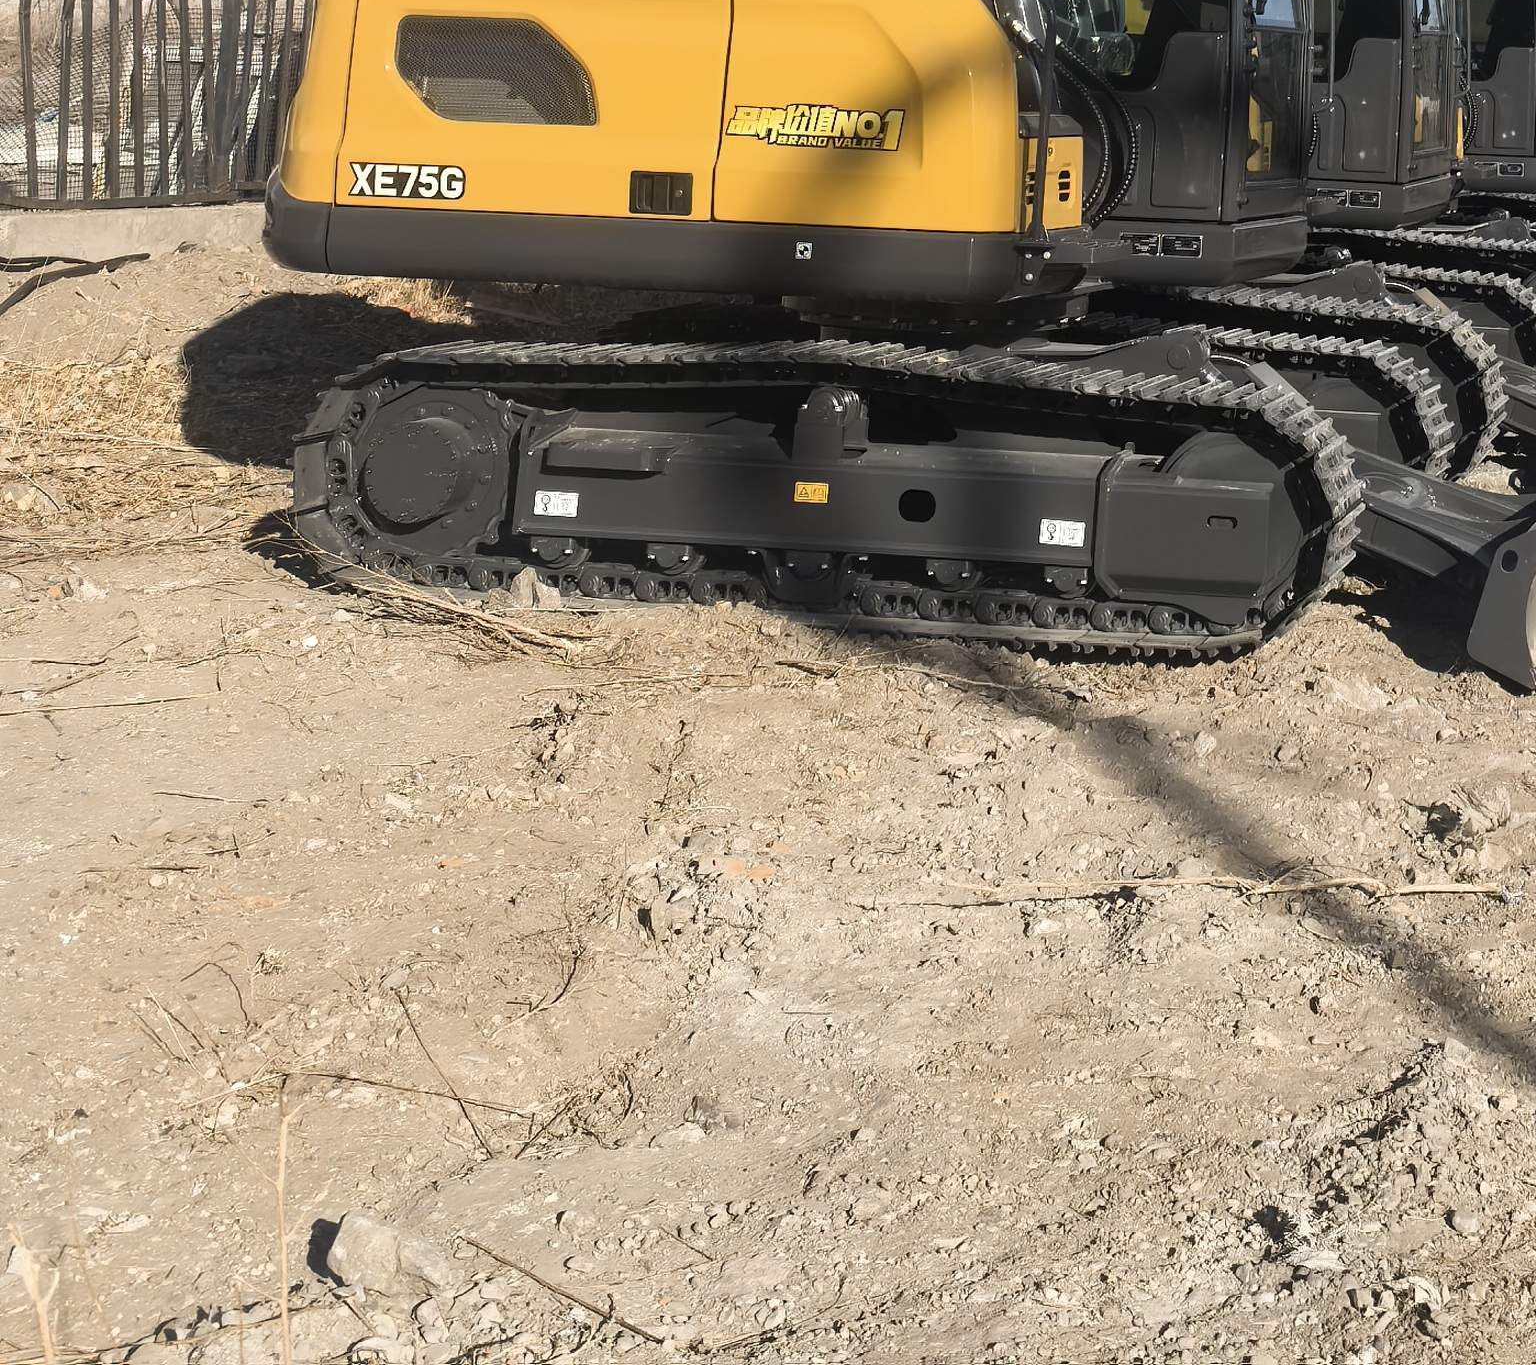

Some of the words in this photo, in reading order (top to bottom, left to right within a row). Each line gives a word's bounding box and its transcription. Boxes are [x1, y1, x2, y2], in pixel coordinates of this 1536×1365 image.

[777, 135, 828, 147] BRAND
[834, 137, 882, 149] VALUE
[350, 163, 464, 199] XE75G
